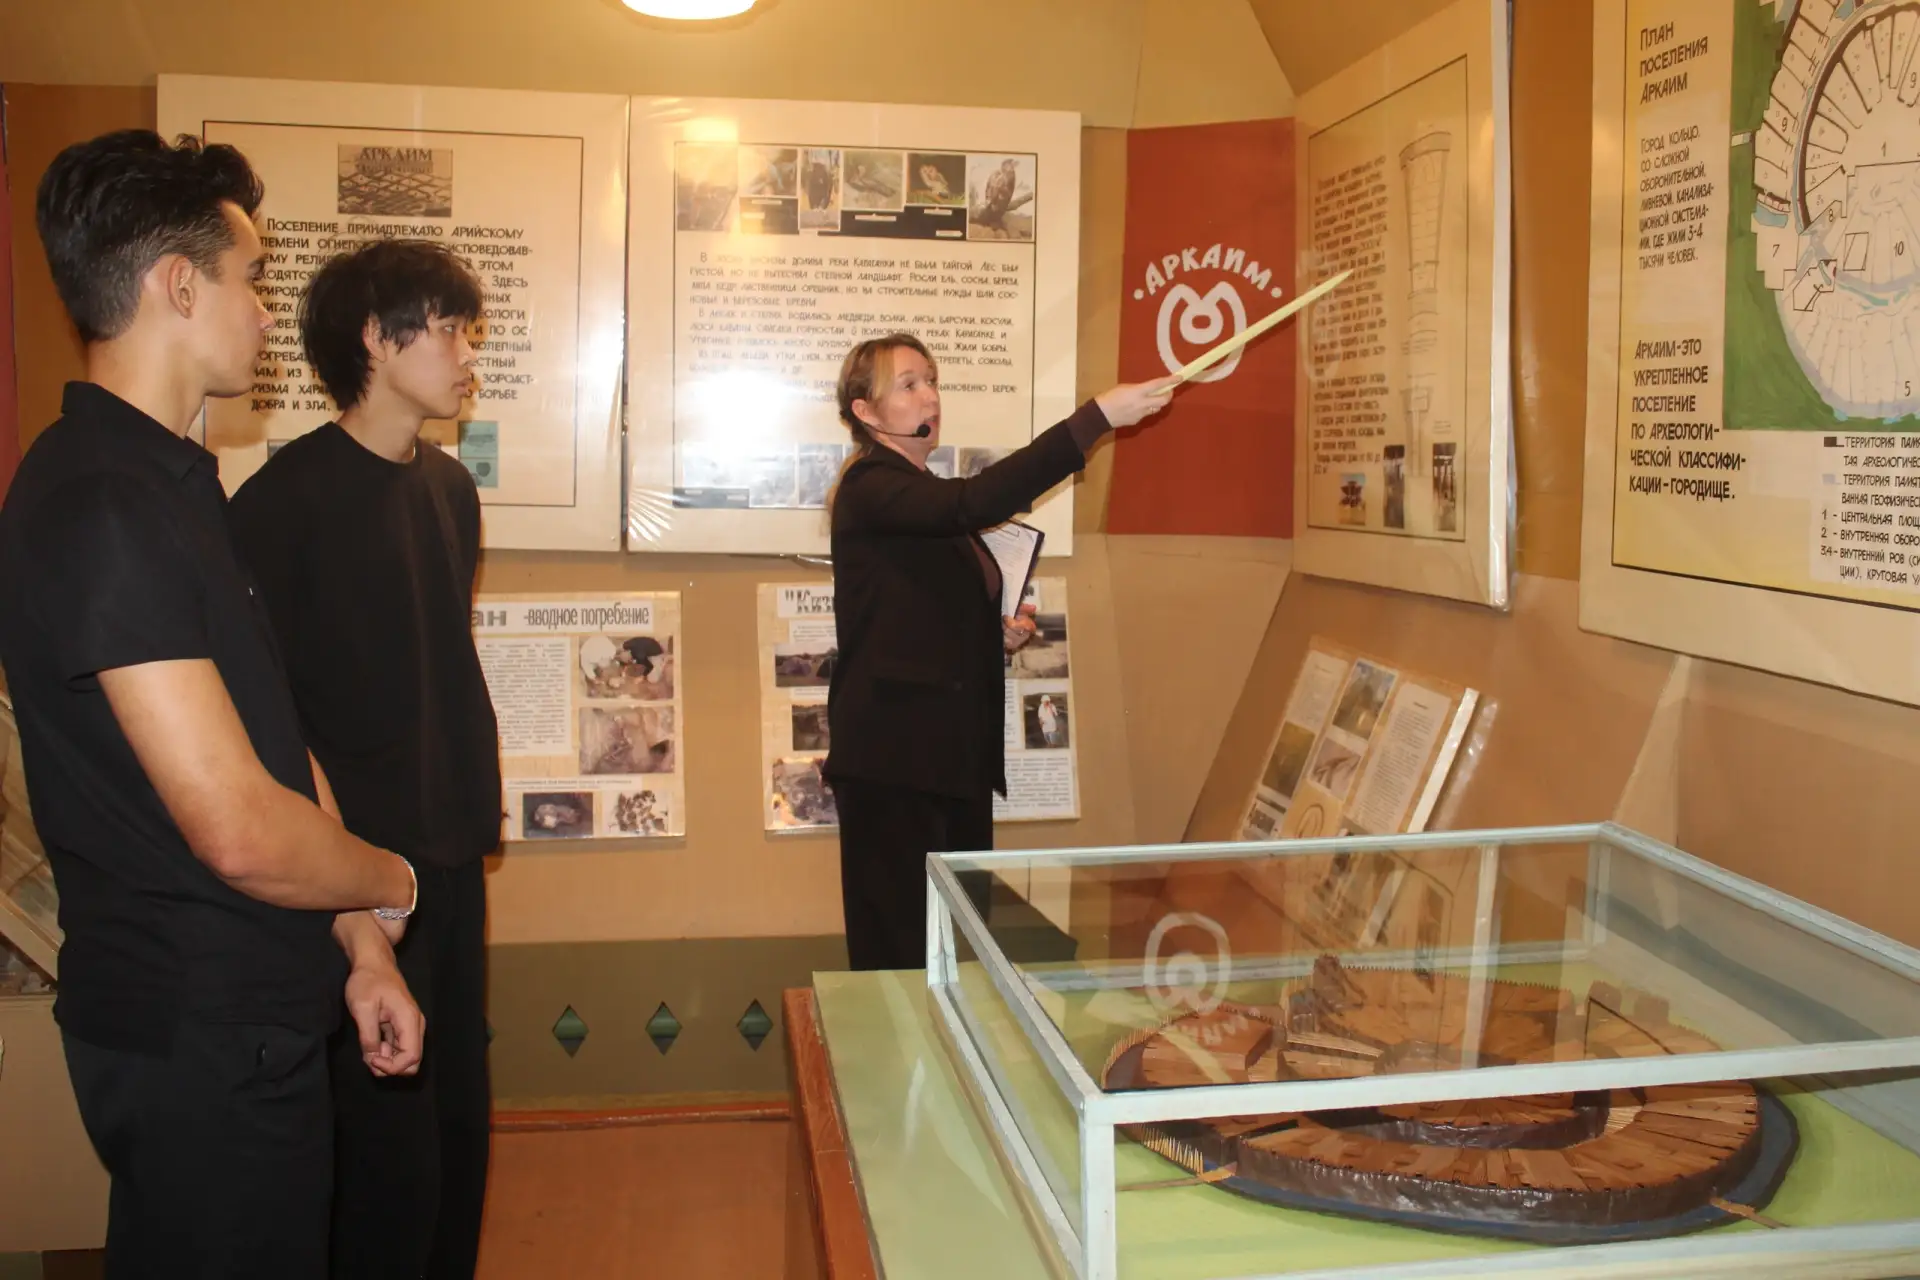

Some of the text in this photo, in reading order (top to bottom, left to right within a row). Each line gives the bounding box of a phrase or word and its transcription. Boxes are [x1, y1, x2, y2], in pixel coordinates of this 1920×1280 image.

[1640, 21, 1674, 51] ПЛАН
[1639, 36, 1708, 78] ПОСЕЛЕНИЯ
[1910, 72, 1917, 88] 9
[1640, 71, 1688, 106] АРКАИМ
[1781, 117, 1788, 132] 9
[1640, 136, 1664, 155] ГОРОД
[1640, 146, 1690, 173] СО СЛОЖНОЙ
[1676, 182, 1714, 204] КАНАЛИЗА-
[1639, 204, 1710, 233] ЦИОННОЙ СИСТЕМА-
[1828, 208, 1834, 222] 8
[268, 218, 524, 239] ПОСЕЛЕНИЕ ПРИНАДЛЕЖАЛО АРИЙСКОМУ
[1652, 233, 1664, 249] ГДЕ
[1666, 229, 1686, 246] ЖИЛИ
[1688, 222, 1704, 242] 3-4
[260, 236, 309, 249] ЛЕМЕНИ
[1894, 241, 1904, 256] 10
[1638, 246, 1698, 270] ТЫСЯЧИ ЧЕЛОВЕК.
[1772, 244, 1780, 258] 7
[264, 254, 514, 271] ЕМУ ЭТОМ
[700, 252, 708, 263] В
[829, 258, 848, 267] РЕКИ
[900, 260, 910, 268] НЕ
[914, 260, 937, 270] БЫЛА
[942, 259, 973, 270] ТАЙГОЙ
[980, 261, 996, 272] ЛЕС
[1146, 244, 1272, 296] АРКАИМ
[492, 276, 528, 288] ЗДЕСЬ
[730, 269, 744, 277] НО
[814, 270, 852, 280] СТЕПНОЙ
[909, 272, 937, 283] РОСЛИ
[846, 286, 858, 294] НО
[943, 288, 972, 298] НУЖДЫ
[976, 290, 994, 298] ШЛИ
[475, 325, 483, 334] И
[490, 325, 506, 335] ПО
[926, 329, 950, 339] РЕКАХ
[1000, 332, 1007, 340] И
[468, 340, 532, 352] КОЛЕПНЫЙ
[954, 342, 978, 352] ЖИЛИ
[1635, 338, 1702, 360] АРКАИМ-ЭТО
[287, 368, 302, 378] ИЗ
[1634, 366, 1708, 386] УКРЕПЛЕННОЕ
[250, 382, 289, 394] РИЗМА
[298, 384, 324, 394] ХАР
[478, 388, 518, 400] БОРЬБЕ
[938, 382, 988, 392] ЫКНОВЕННО
[1904, 381, 1910, 397] 5
[250, 400, 331, 412] ДОБРА И ЗЛА.
[1632, 395, 1696, 413] ПОСЕЛЕНИЕ
[1631, 422, 1720, 440] ПО АРХЕОЛОГИ-
[1844, 436, 1895, 448] ТЕРРИТОРИЯ
[1630, 446, 1746, 471] ЧЕСКОЙ КЛАССИФИ-
[1844, 456, 1858, 466] ТАЯ
[1843, 474, 1890, 486] ТЕРРИТОРИЯ
[1842, 492, 1920, 508] ВАННАЯ ГЕОФИЗИЧЕС
[1822, 508, 1828, 520] 1
[1841, 511, 1893, 526] ЦЕНТРАЛЬНАЯ
[1821, 526, 1828, 538] 2
[1840, 529, 1890, 544] ВНУТРЕННЯЯ
[1840, 548, 1885, 562] ВНУТРЕННИЙ
[1890, 552, 1904, 564] РОВ
[1866, 568, 1908, 584] КРУГОВАЯ
[581, 602, 649, 632] погребение
